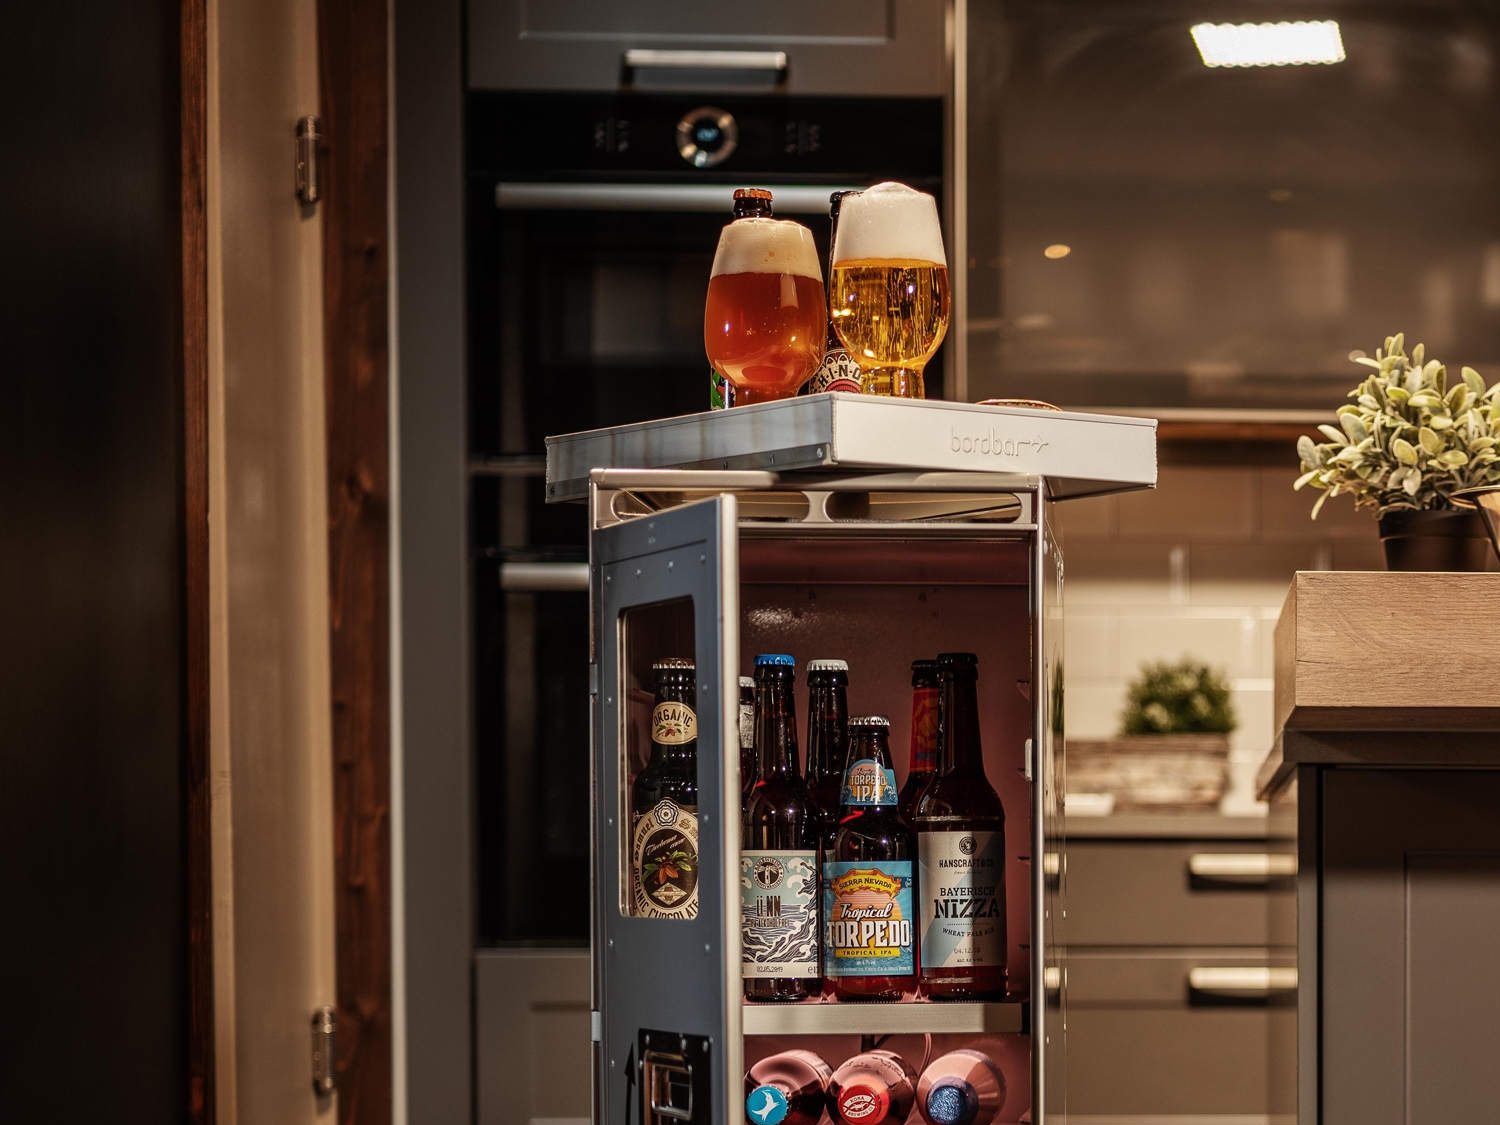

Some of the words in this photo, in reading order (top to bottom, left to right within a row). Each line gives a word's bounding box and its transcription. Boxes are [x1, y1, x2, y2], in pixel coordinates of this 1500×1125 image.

[950, 425, 1030, 457] bordbar
[653, 708, 693, 727] ORGANIC
[856, 785, 881, 802] IPA
[634, 867, 650, 913] ORGANIC
[839, 877, 863, 889] SIERRA
[864, 877, 892, 889] NEVADA
[939, 887, 995, 896] BAYERISCH
[840, 902, 893, 921] Tropical
[933, 898, 1000, 919] NIZZA
[826, 920, 910, 948] TORPEDO
[942, 927, 965, 938] WHEAT
[966, 930, 983, 938] PALE
[984, 926, 995, 936] ALE
[847, 1107, 869, 1117] BREWING
